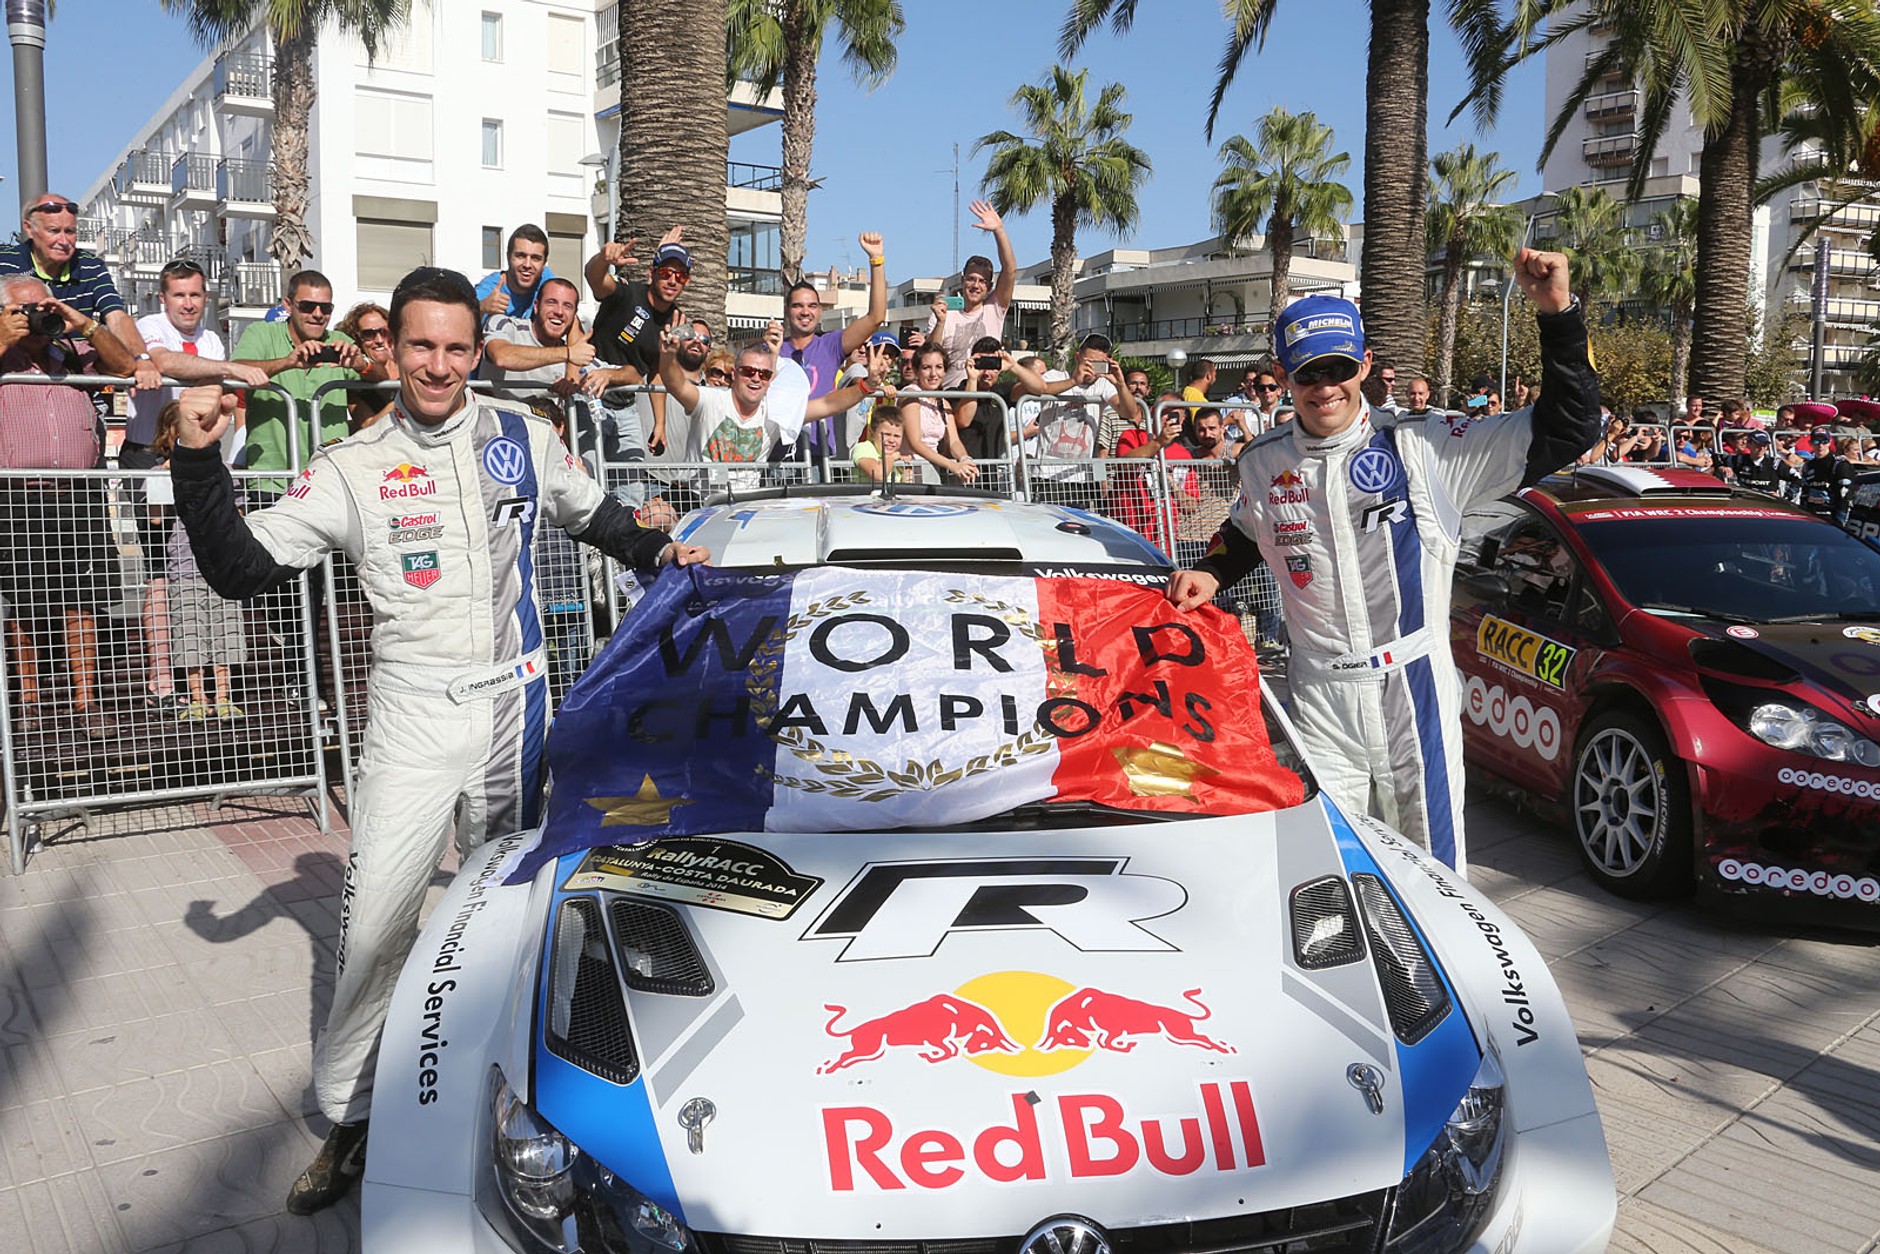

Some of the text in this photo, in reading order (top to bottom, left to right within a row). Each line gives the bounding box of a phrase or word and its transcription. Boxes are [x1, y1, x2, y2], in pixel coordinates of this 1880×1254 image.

[287, 484, 312, 500] ull
[380, 480, 437, 500] Red Bull
[1269, 487, 1309, 505] Red Bull
[401, 513, 437, 528] Castrol
[1622, 510, 1643, 518] FIA
[1643, 509, 1672, 517] WRC
[1686, 508, 1764, 519] Championship
[388, 525, 444, 544] EDGE
[406, 570, 438, 586] HEUER
[408, 555, 433, 569] TAG
[656, 613, 1206, 678] WORLD
[1484, 620, 1535, 669] RACC
[1538, 643, 1567, 686] 32
[627, 680, 1216, 743] CHAMPIONS
[1464, 676, 1560, 758] edoo
[646, 847, 764, 876] RallyRACC
[705, 880, 728, 890] 2014
[716, 874, 797, 897] DAURADA
[1721, 861, 1879, 899] ooredoo
[799, 856, 1188, 963] R
[432, 900, 488, 974] Financial
[1460, 902, 1539, 1047] Volkswagen
[419, 979, 457, 1106] Services
[822, 1081, 1267, 1191] Red Bull
